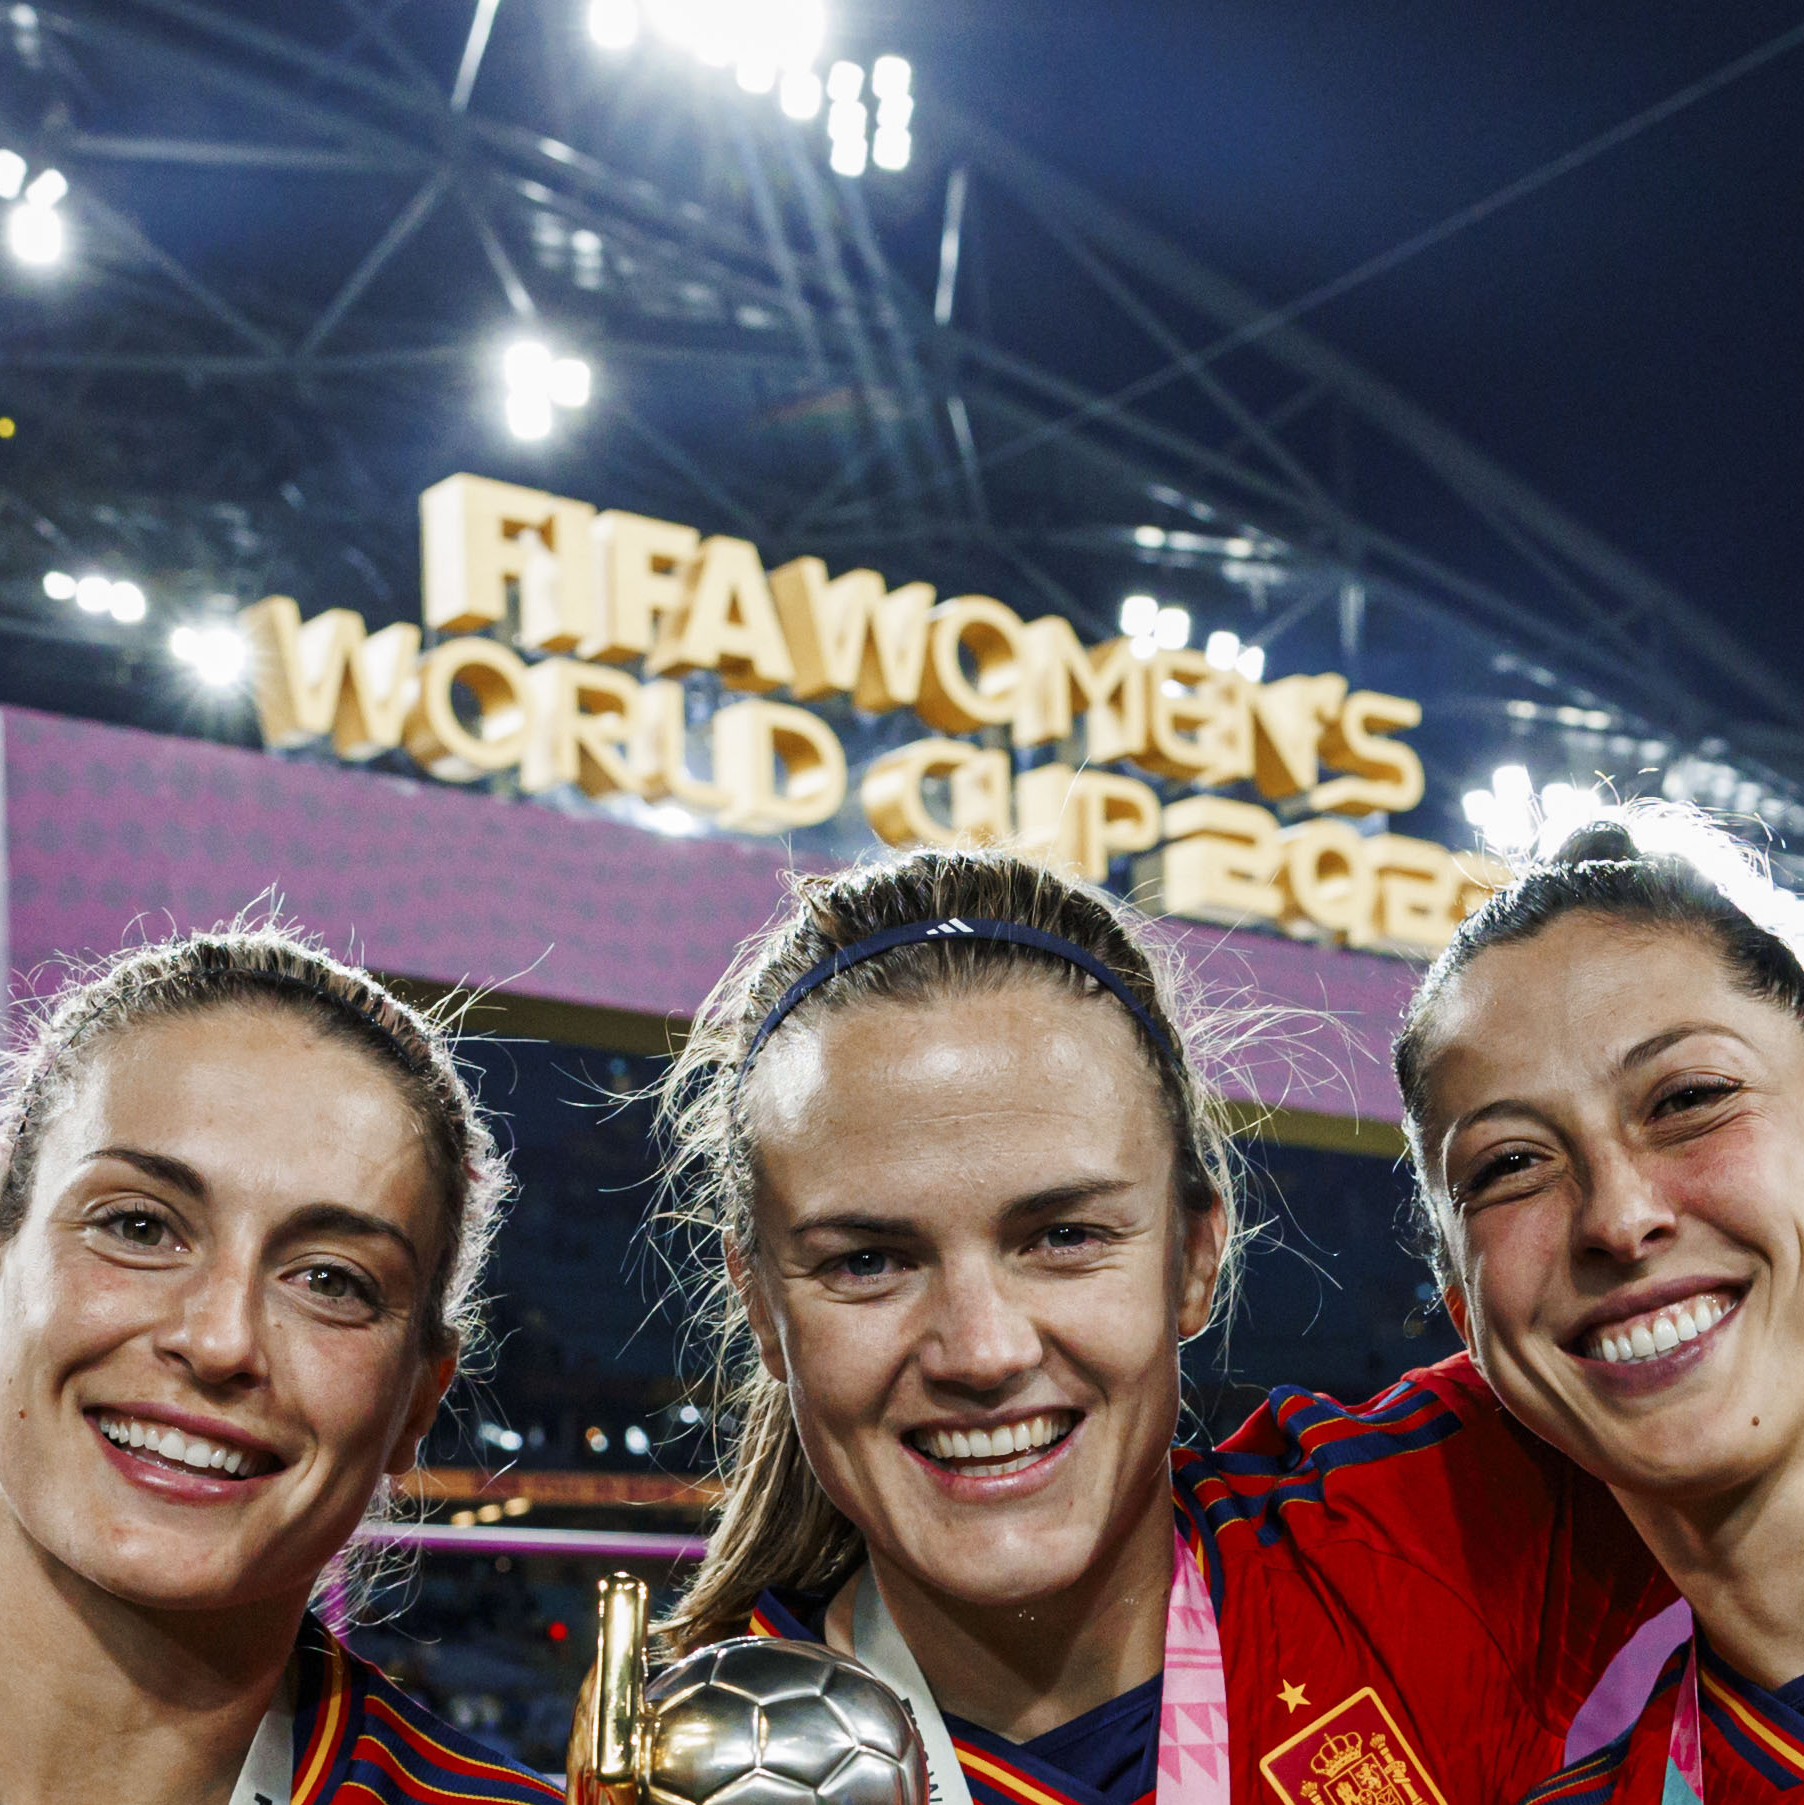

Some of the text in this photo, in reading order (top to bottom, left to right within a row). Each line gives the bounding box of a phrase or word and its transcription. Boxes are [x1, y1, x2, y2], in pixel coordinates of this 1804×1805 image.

[245, 594, 1505, 950] WORLD CUP 202
[419, 473, 1425, 816] FIFA WOMEN'S
